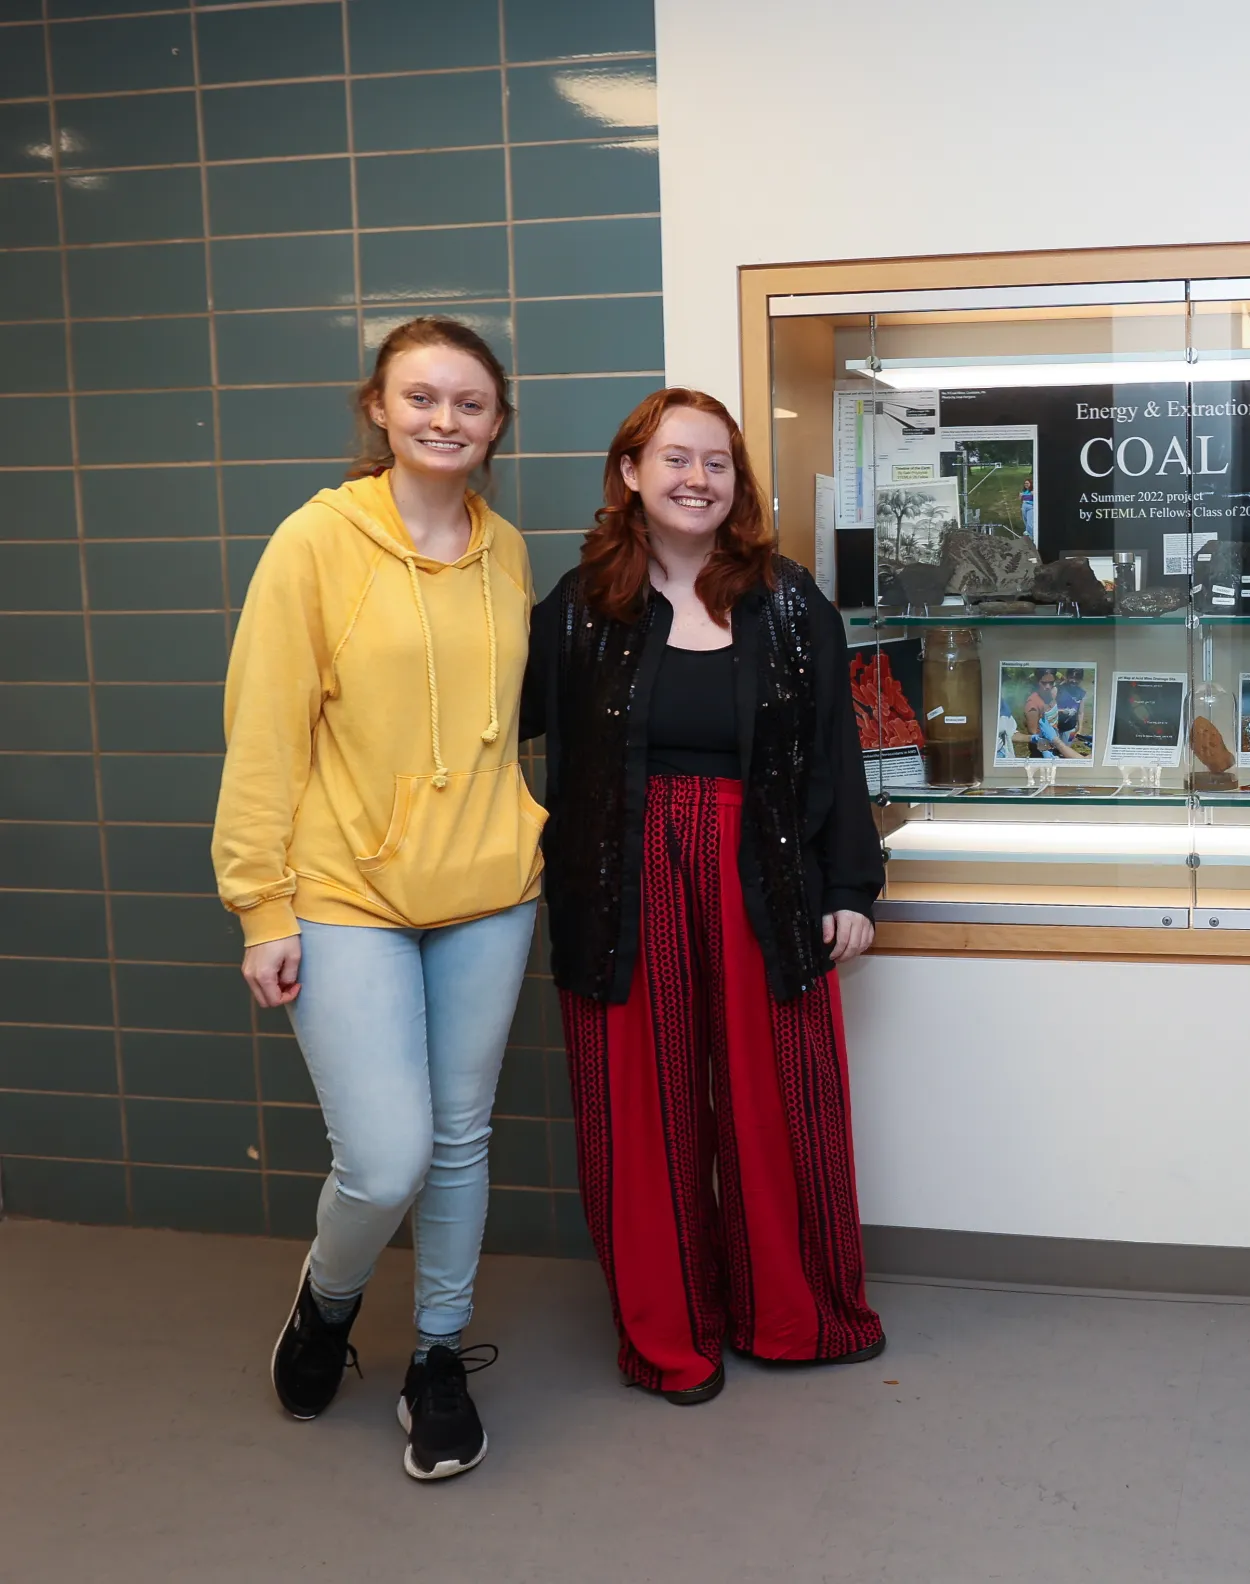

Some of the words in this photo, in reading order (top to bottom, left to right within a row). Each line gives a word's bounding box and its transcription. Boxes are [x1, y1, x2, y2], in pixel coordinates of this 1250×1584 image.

[1076, 403, 1139, 423] Energy
[1143, 400, 1161, 418] &
[1080, 435, 1229, 478] COAL
[1079, 492, 1089, 504] A
[1090, 492, 1136, 504] Summer
[1137, 491, 1164, 503] 2022
[1166, 490, 1204, 504] project
[1079, 508, 1093, 522] by
[1095, 508, 1147, 520] STEMLA
[1149, 507, 1192, 519] Fellows
[1193, 506, 1223, 518] Class
[1225, 505, 1237, 517] of
